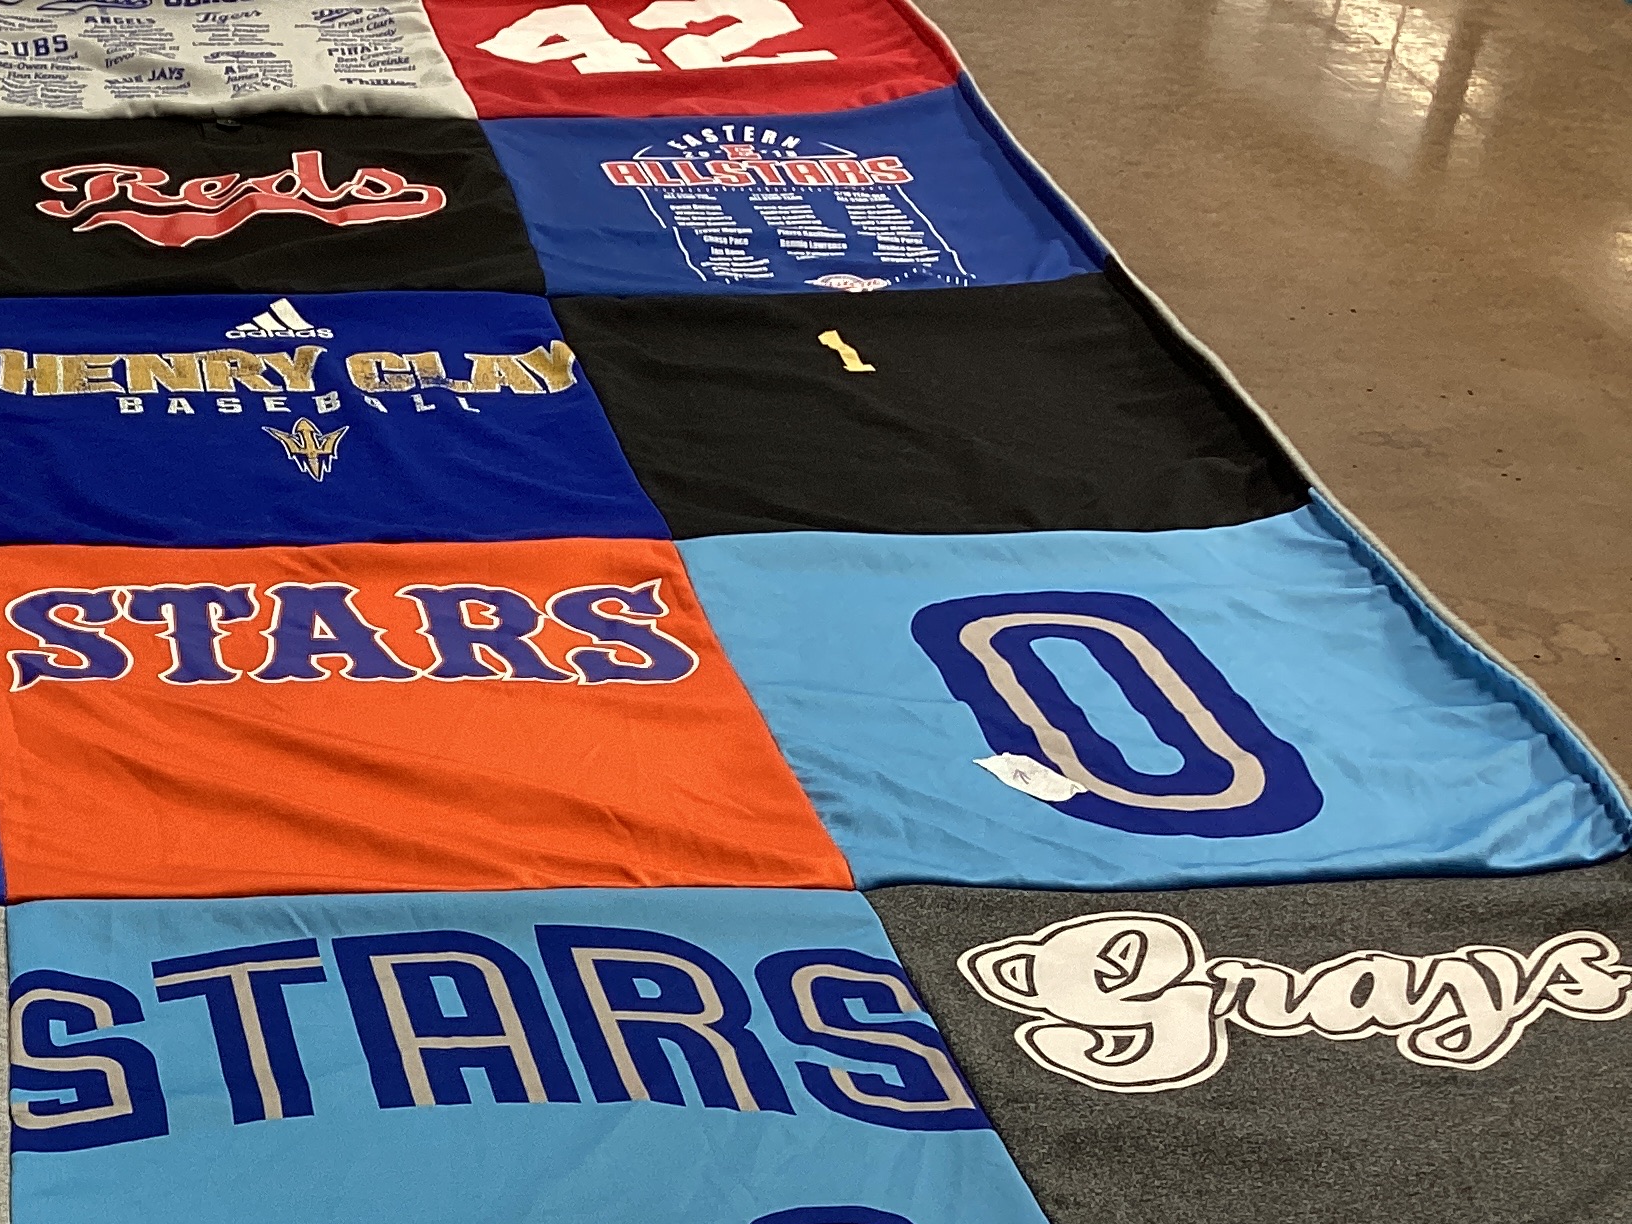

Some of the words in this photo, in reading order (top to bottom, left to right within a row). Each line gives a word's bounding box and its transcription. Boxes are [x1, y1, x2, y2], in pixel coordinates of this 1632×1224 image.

[195, 9, 262, 24] Tigers
[366, 17, 396, 31] Clark
[476, 0, 838, 74] 42
[147, 66, 185, 82] JAYS
[667, 124, 802, 150] EASTERN
[36, 151, 447, 240] Reds
[225, 328, 334, 339] adidas
[817, 329, 877, 372] 1
[345, 339, 578, 395] CLAY
[117, 391, 481, 415] BASEBALL
[5, 579, 699, 692] STARS
[911, 590, 1325, 839] 0
[956, 911, 1632, 1094] Grays
[9, 924, 995, 1152] STARS
